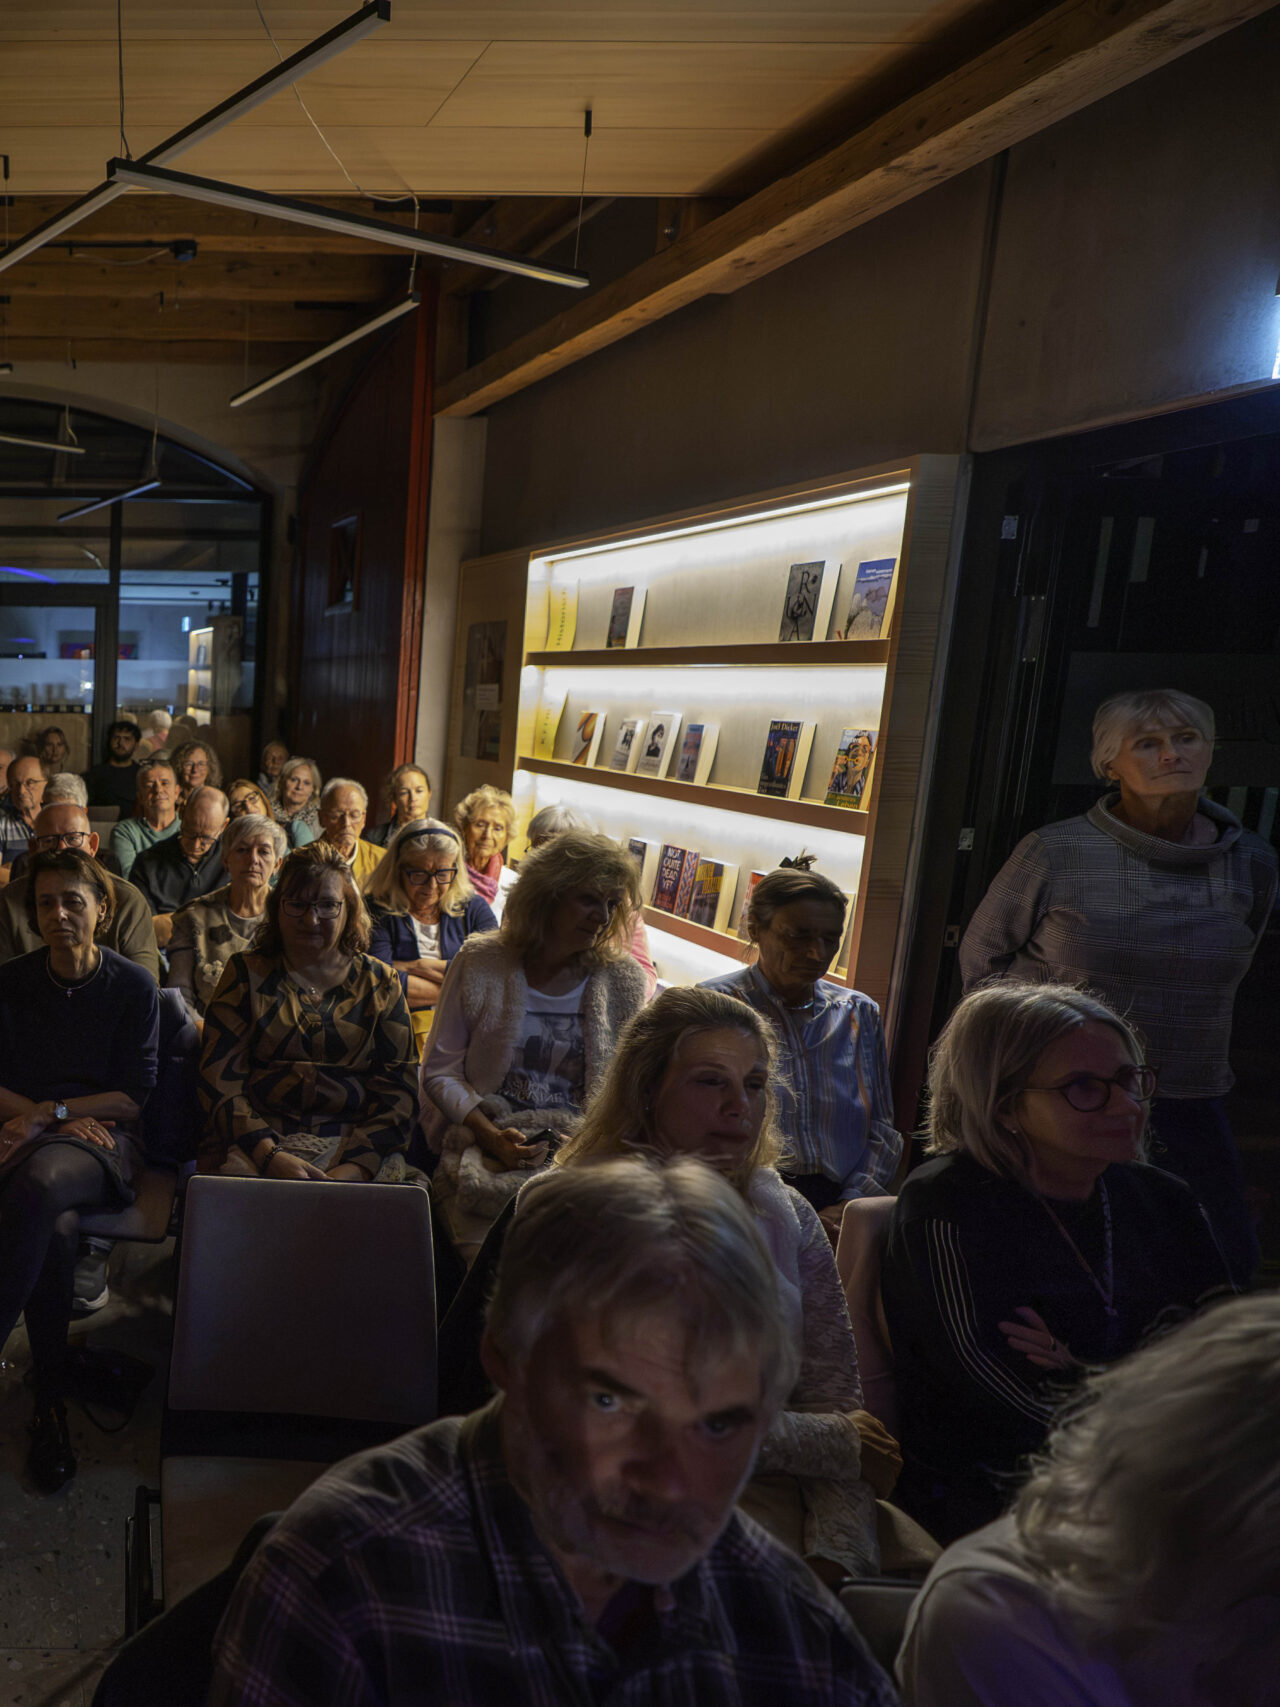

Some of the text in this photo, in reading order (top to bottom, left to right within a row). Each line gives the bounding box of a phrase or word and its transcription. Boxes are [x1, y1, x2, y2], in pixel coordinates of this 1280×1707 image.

[781, 722, 799, 731] Dicker
[667, 847, 682, 857] NOT
[663, 857, 682, 870] QUITE
[662, 867, 678, 881] DEAD
